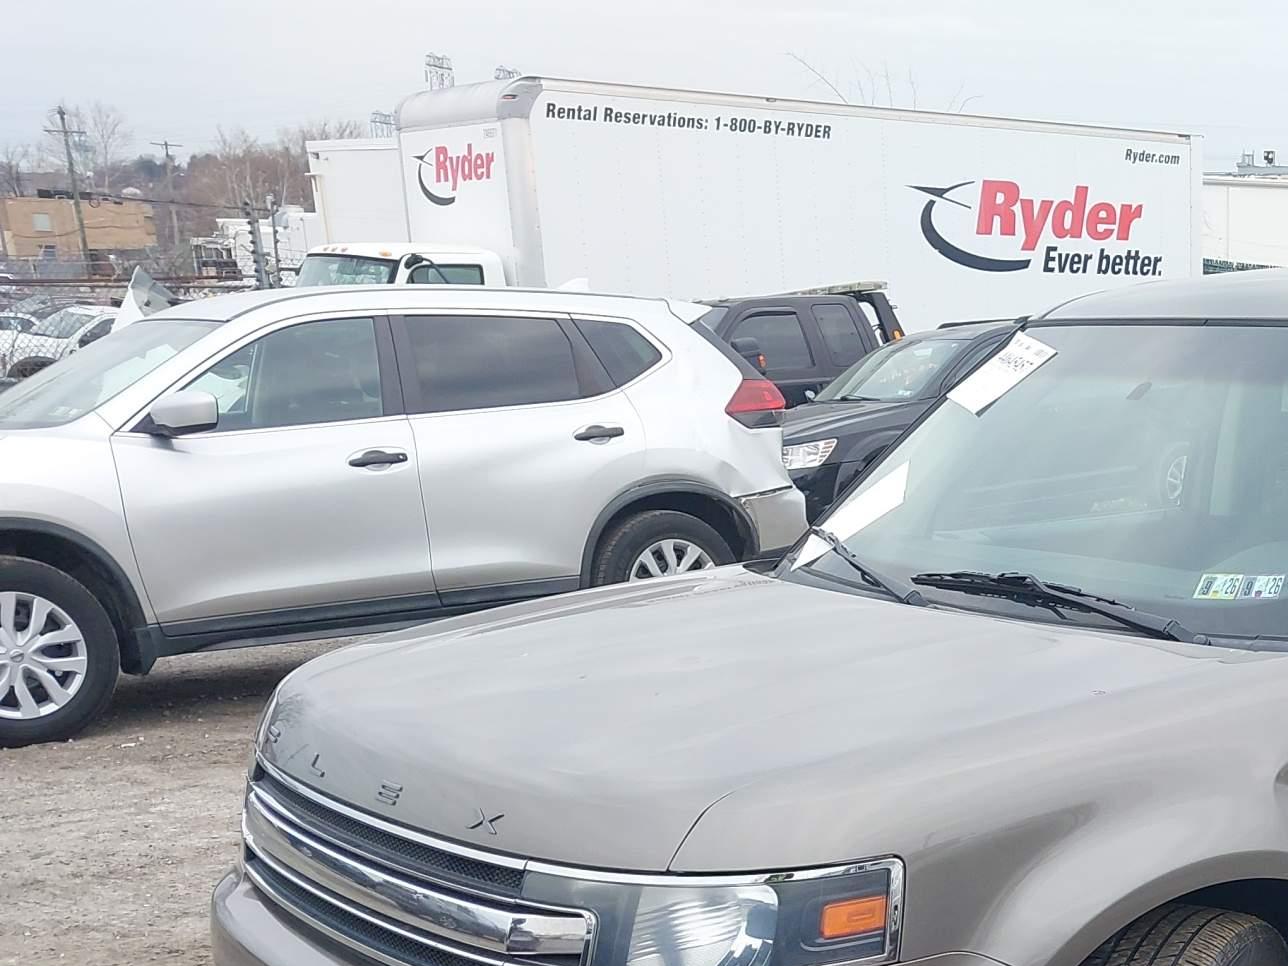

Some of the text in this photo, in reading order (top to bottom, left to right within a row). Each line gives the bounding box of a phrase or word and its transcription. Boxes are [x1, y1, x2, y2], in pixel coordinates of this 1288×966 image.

[546, 103, 832, 139] Rental Reservations: 1-800-BY-RYDER
[435, 143, 494, 191] Ryder
[1125, 148, 1180, 165] Ryder.com
[976, 179, 1143, 251] Ryder
[1043, 246, 1162, 276] Ever better.
